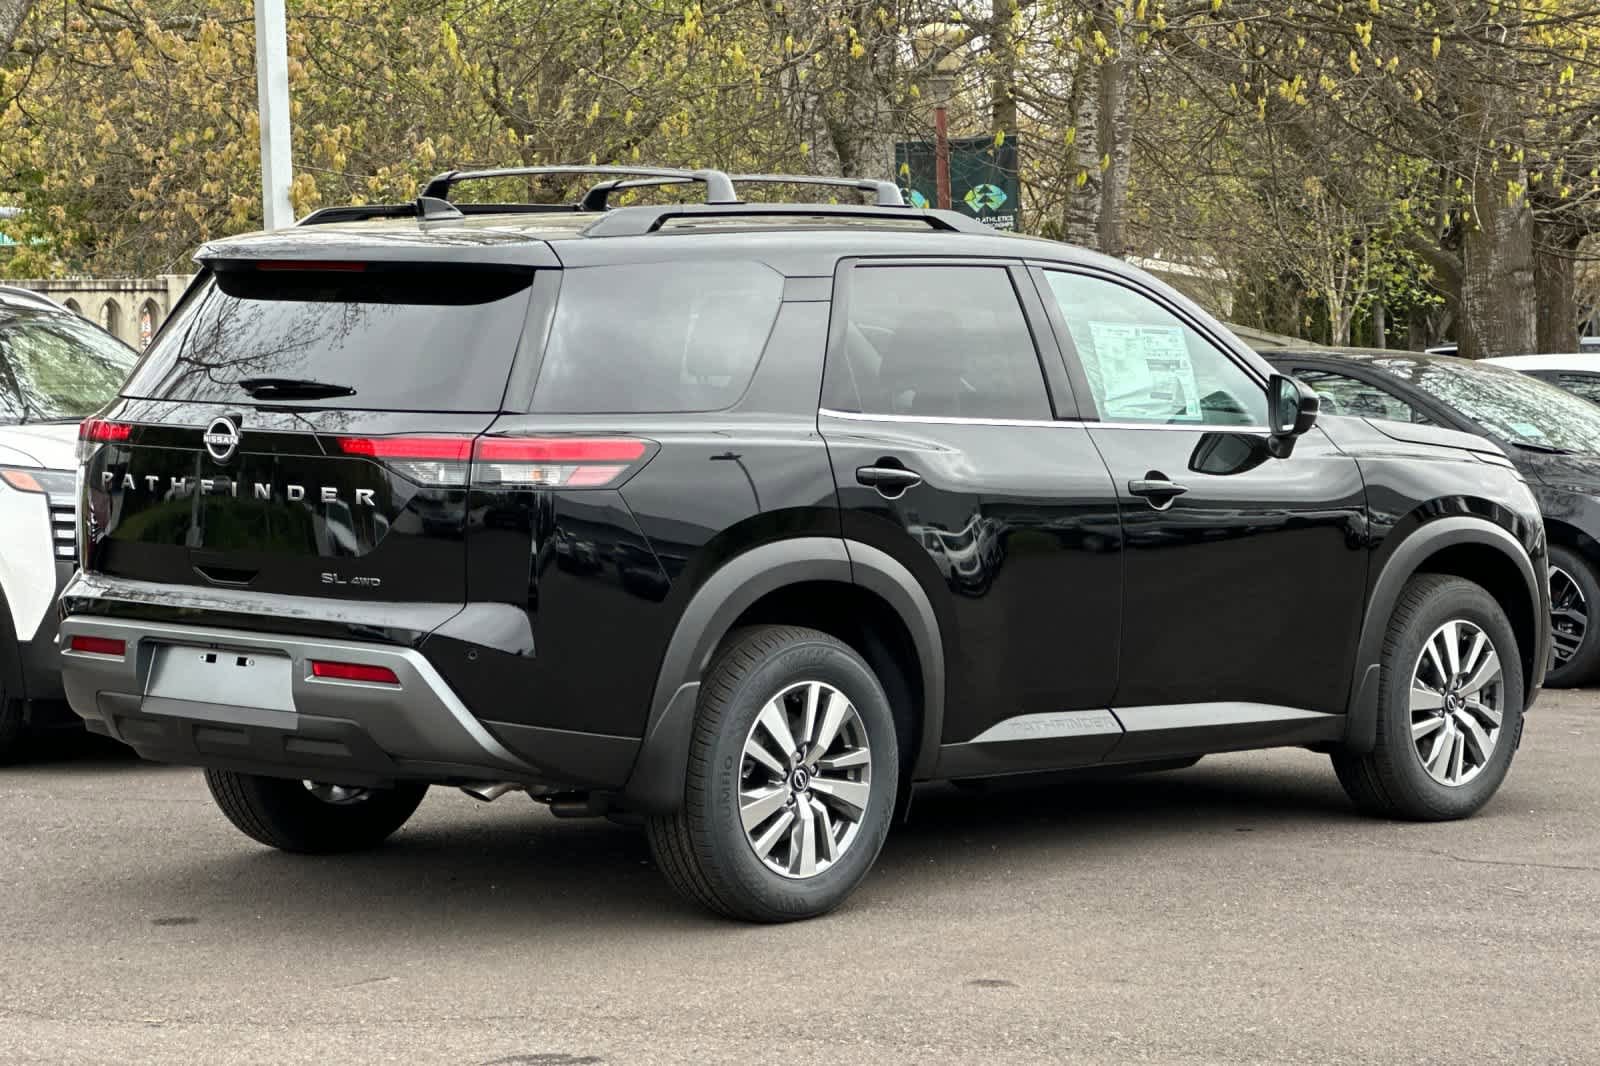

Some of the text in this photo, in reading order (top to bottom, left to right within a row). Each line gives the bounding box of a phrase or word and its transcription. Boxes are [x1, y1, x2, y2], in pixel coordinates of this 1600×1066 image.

[203, 432, 238, 445] NISSAN
[101, 471, 376, 506] PATHFINDER
[321, 572, 381, 586] SL 4WD
